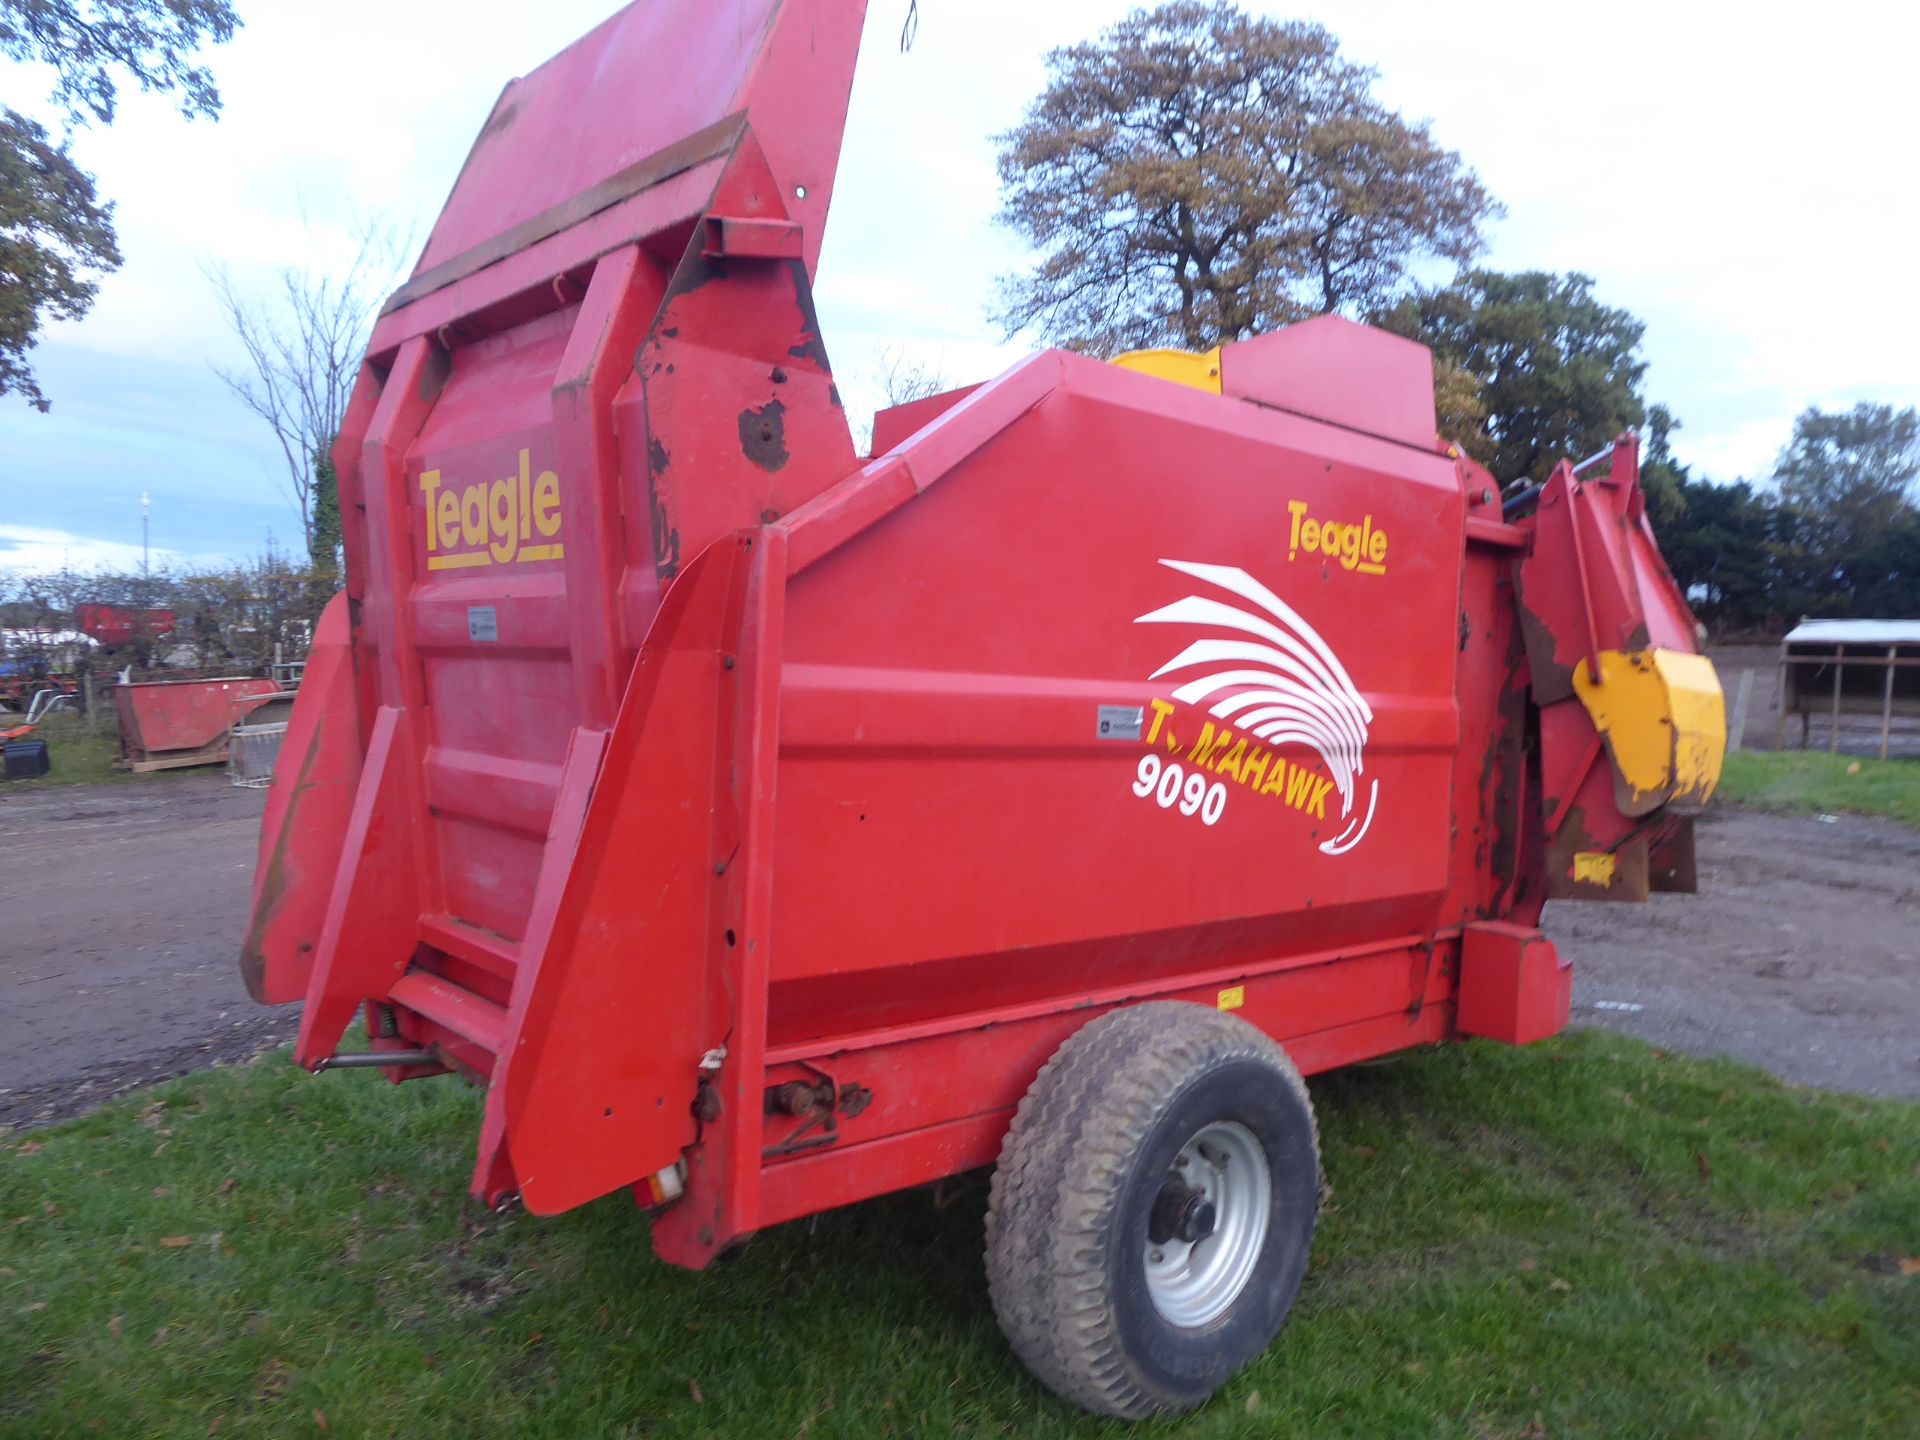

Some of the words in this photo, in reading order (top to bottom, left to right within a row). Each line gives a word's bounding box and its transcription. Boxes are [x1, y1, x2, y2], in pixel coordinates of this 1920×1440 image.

[419, 448, 563, 565] Teagle
[1287, 500, 1388, 572] Teagle
[1132, 754, 1227, 826] 9090
[1146, 697, 1334, 820] TMAHAWK
